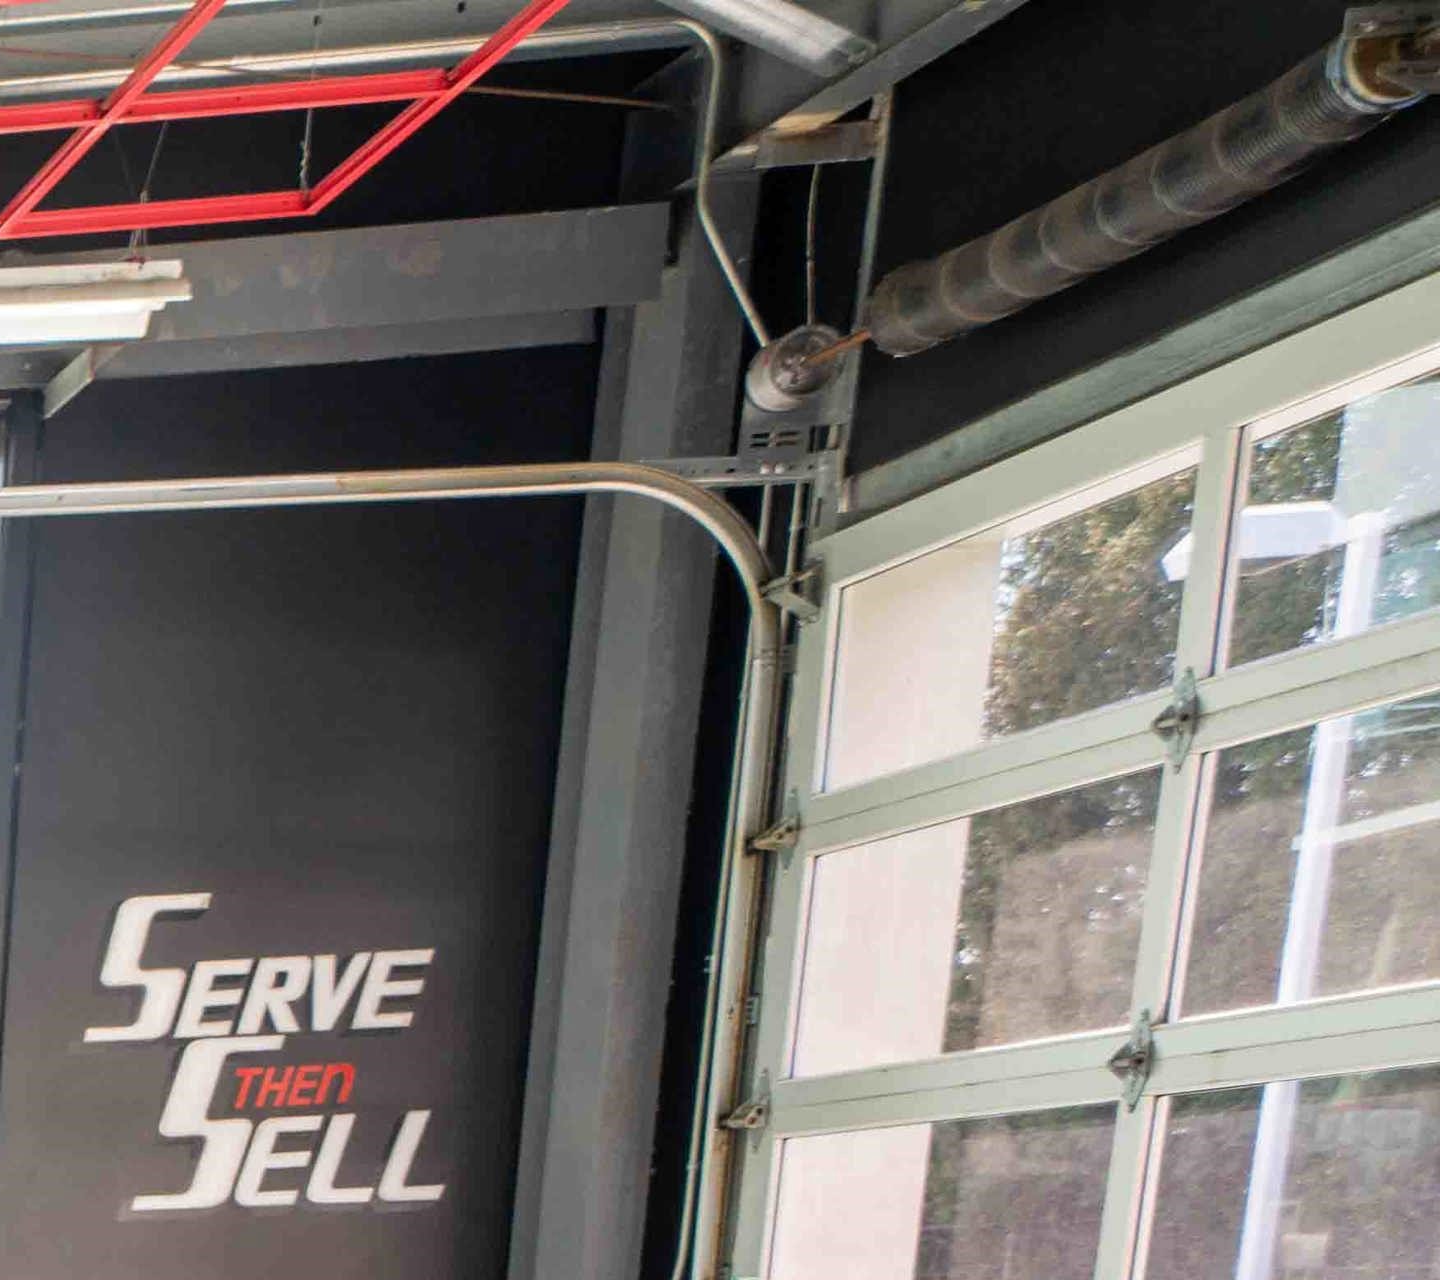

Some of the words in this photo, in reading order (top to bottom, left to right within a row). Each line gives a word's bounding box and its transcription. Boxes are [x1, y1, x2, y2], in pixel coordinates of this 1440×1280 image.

[83, 892, 435, 1043] SERVE
[131, 1034, 447, 1212] SELL
[234, 1062, 356, 1110] THEN
